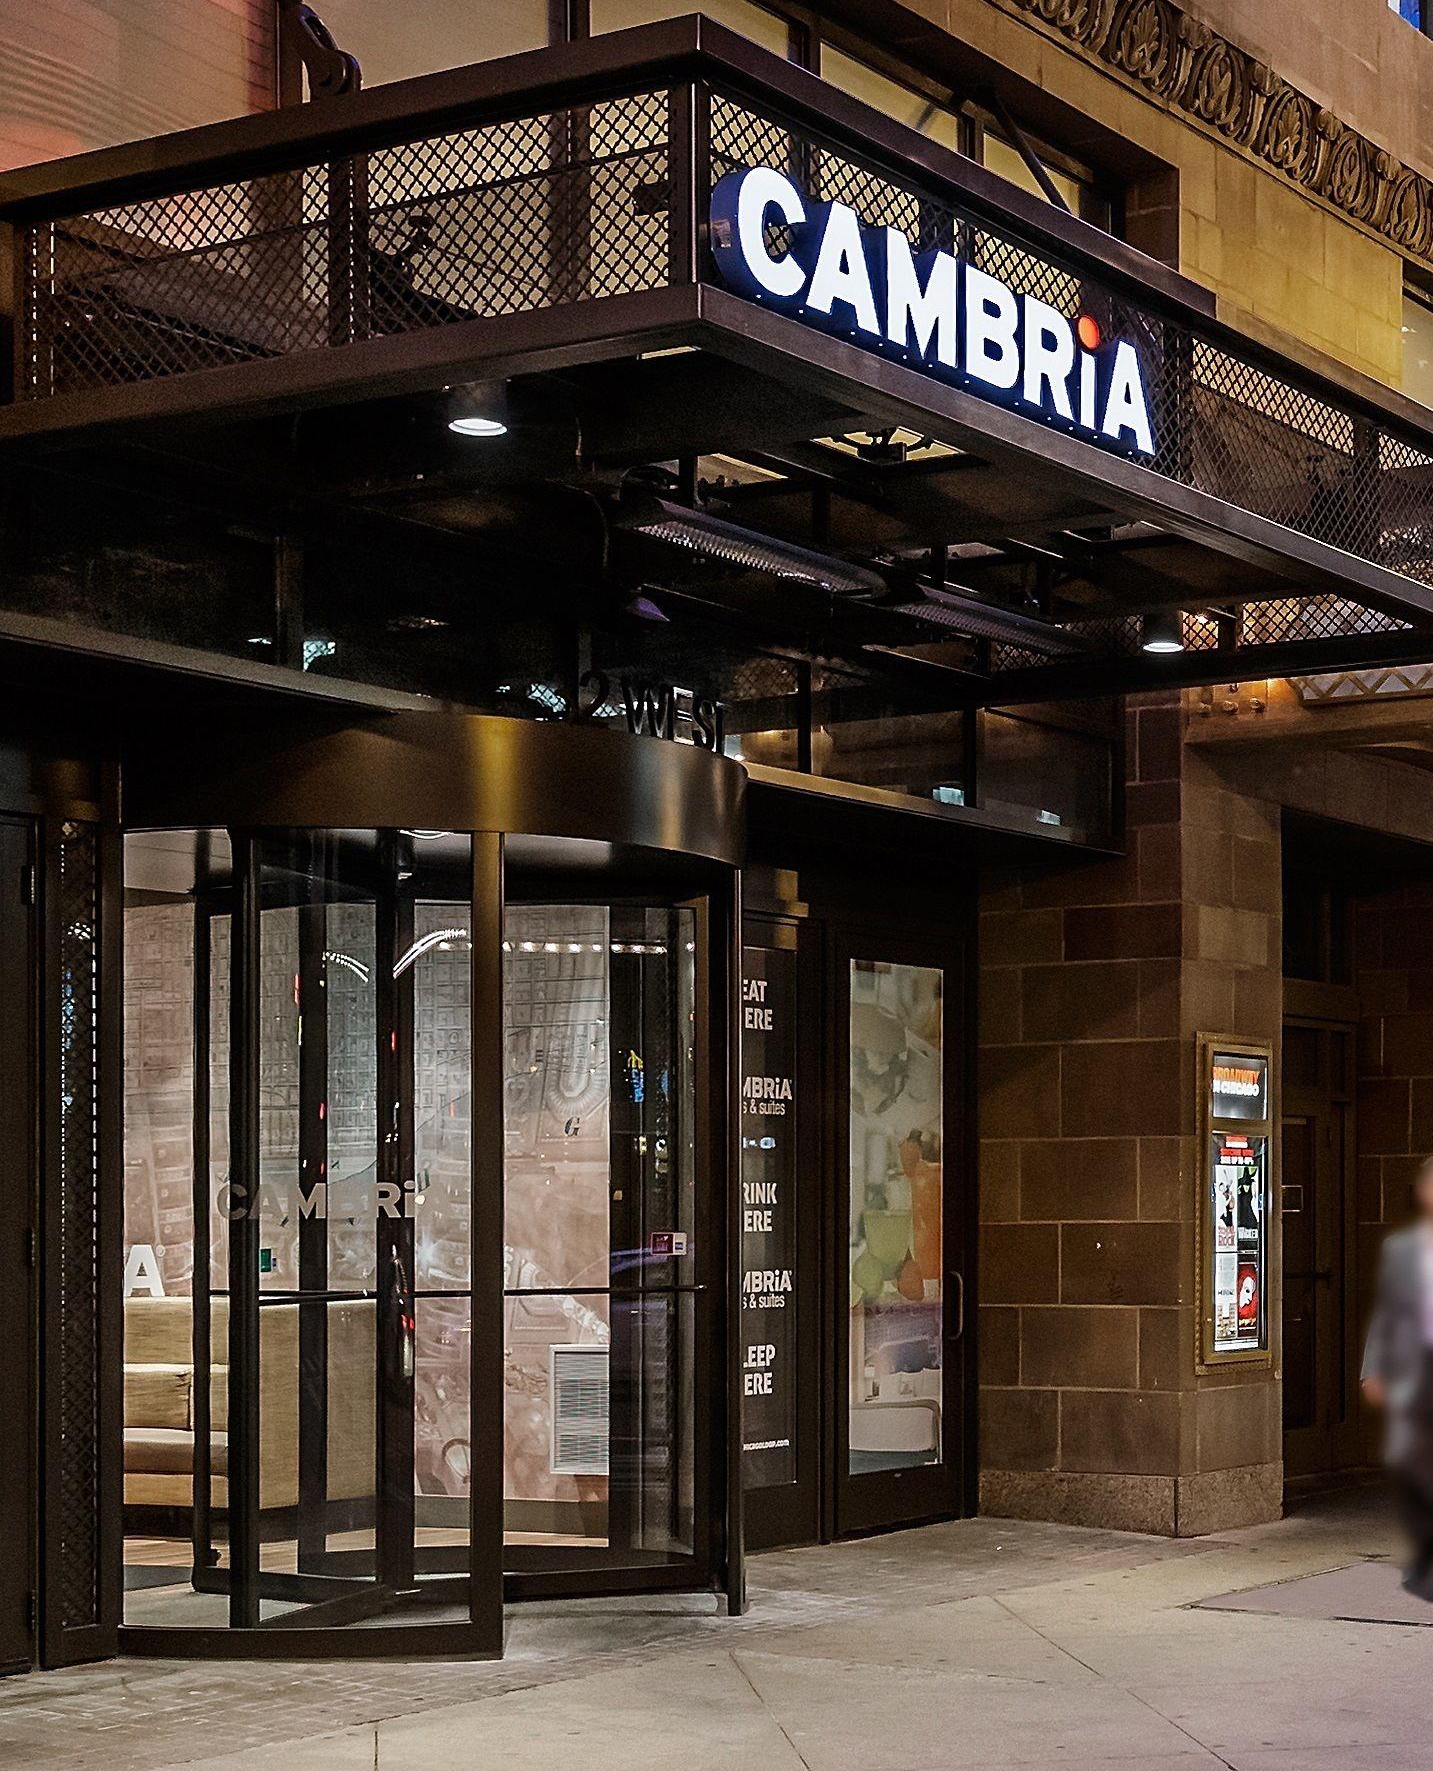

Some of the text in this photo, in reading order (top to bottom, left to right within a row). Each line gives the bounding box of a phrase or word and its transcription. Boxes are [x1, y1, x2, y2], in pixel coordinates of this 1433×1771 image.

[744, 1007, 773, 1030] ERE
[750, 1099, 758, 1114] &
[759, 1101, 786, 1116] suites
[743, 1182, 778, 1205] RINK
[743, 1210, 773, 1232] ERE
[749, 1294, 757, 1308] &
[758, 1294, 785, 1309] suites
[743, 1344, 776, 1368] EEP
[744, 1372, 773, 1396] ERE
